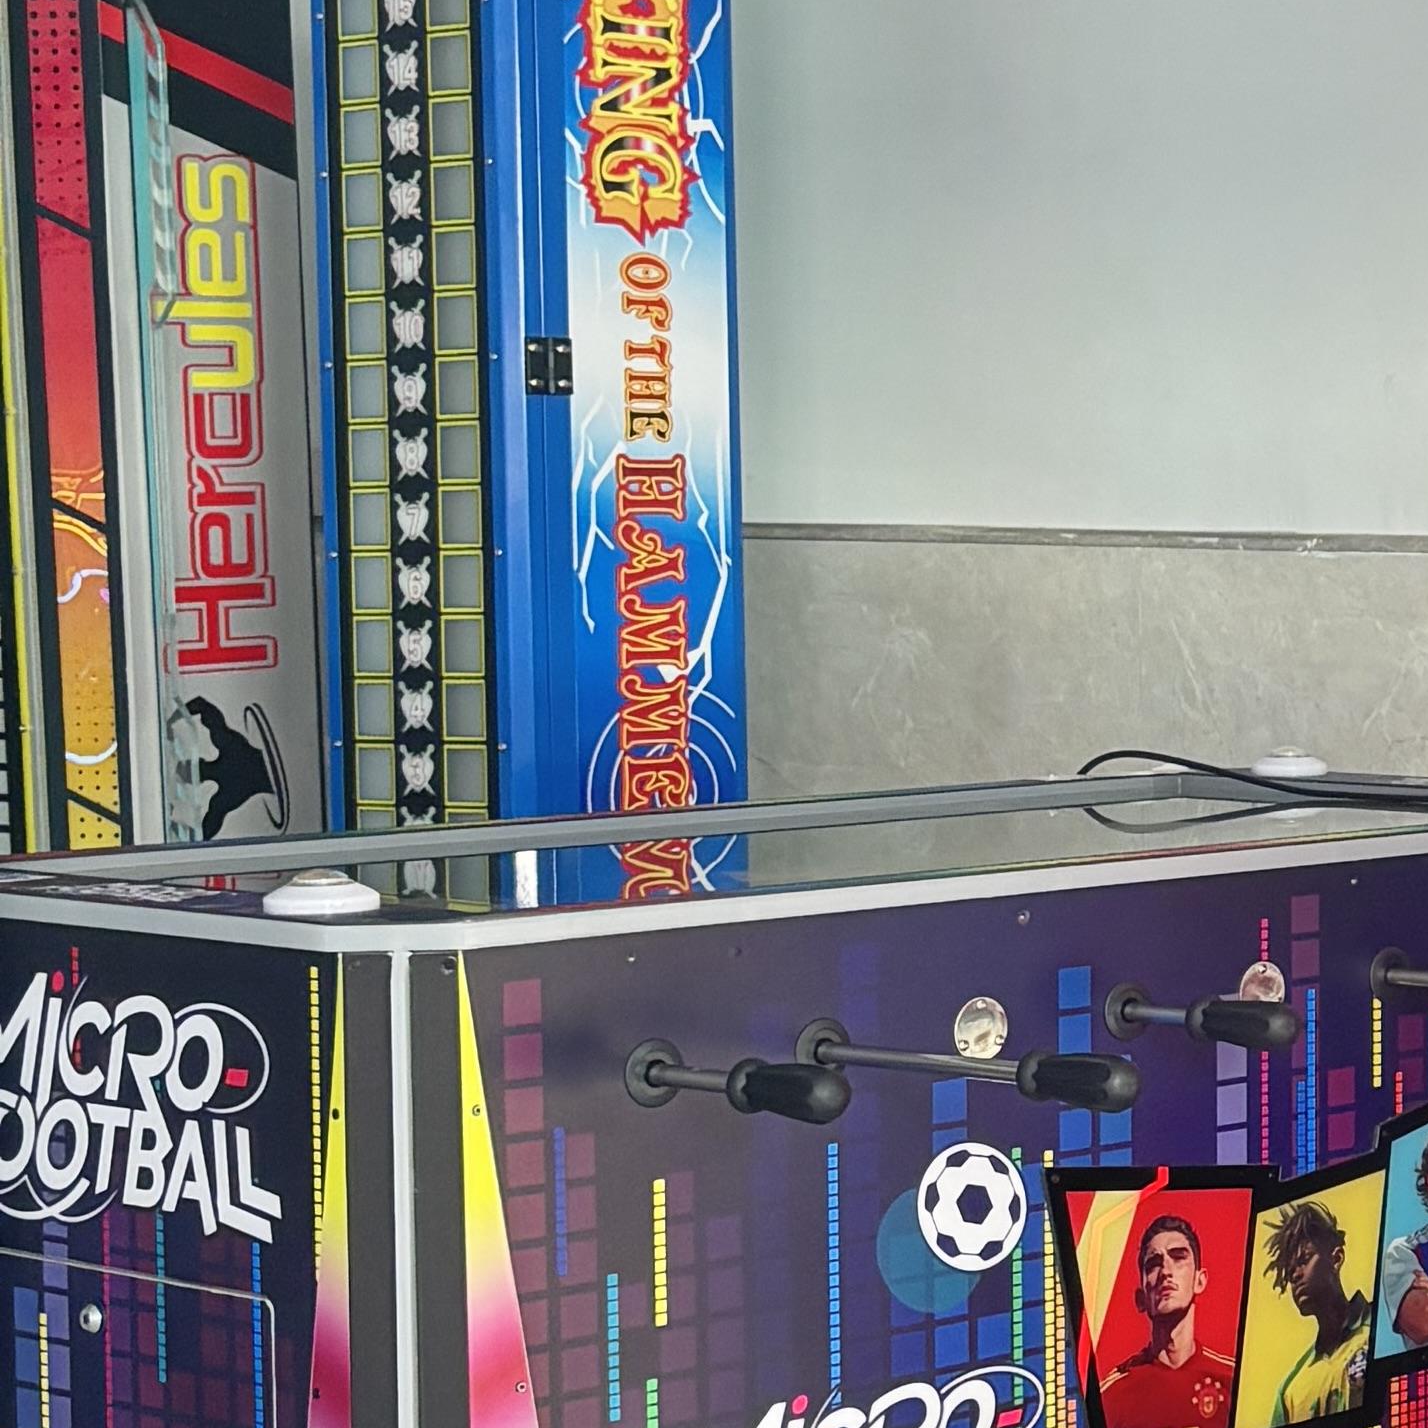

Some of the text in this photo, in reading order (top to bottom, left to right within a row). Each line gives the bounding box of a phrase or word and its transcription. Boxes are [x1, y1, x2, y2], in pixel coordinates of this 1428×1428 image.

[150, 155, 278, 674] Hercules
[614, 250, 694, 811] OF THE HAMME
[0, 1089, 282, 1245] OOTBALL
